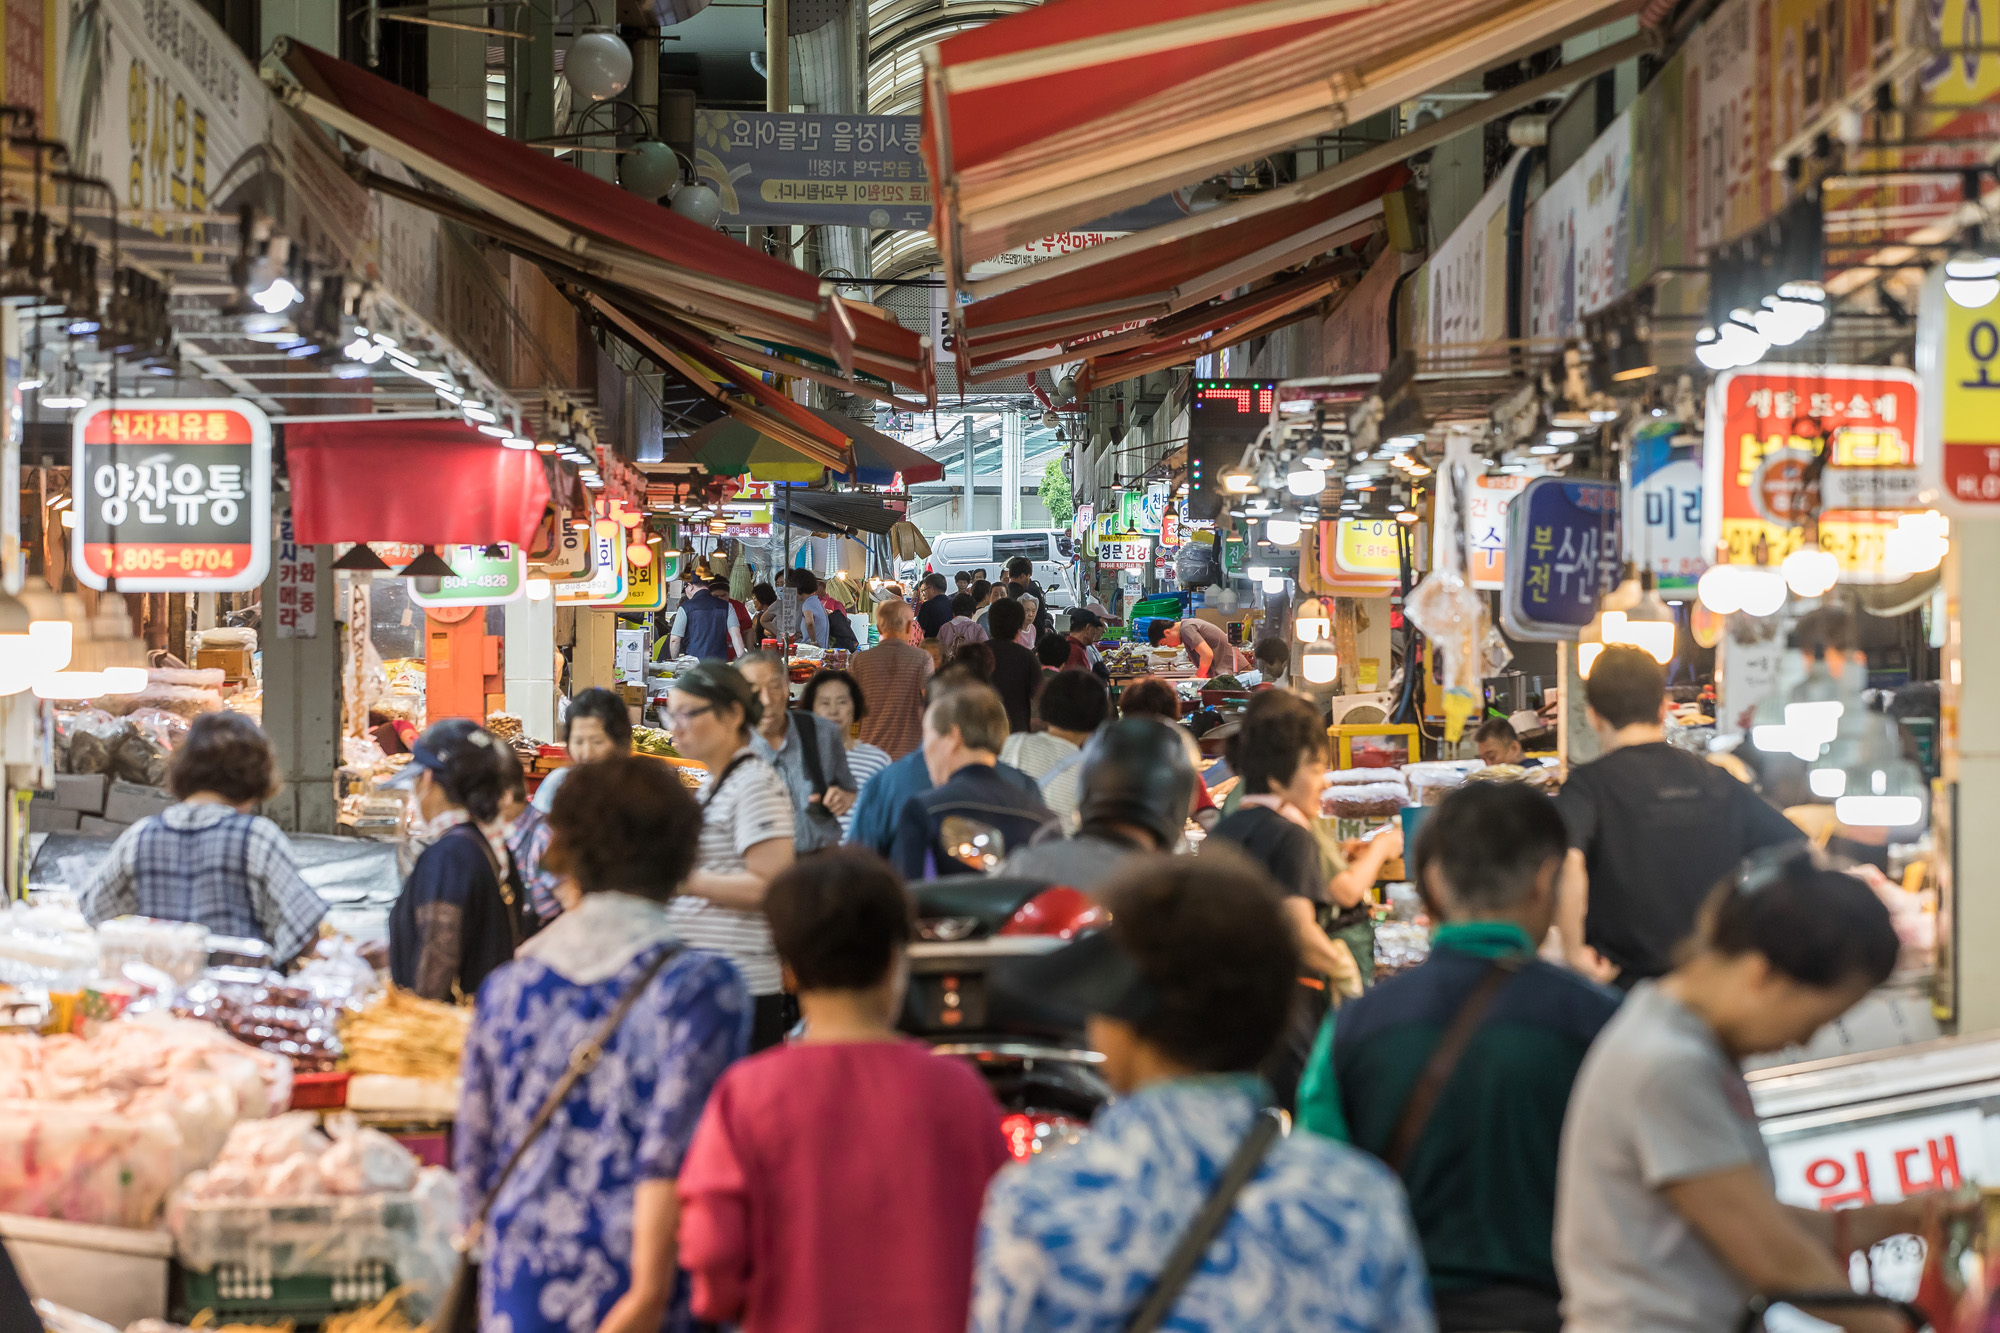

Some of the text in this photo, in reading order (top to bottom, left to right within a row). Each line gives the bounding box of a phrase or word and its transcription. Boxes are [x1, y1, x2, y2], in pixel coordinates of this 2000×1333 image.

[111, 412, 229, 441] 식자재유통
[94, 462, 245, 526] 양산유통
[101, 548, 234, 572] T.805-8704
[1101, 543, 1123, 560] 성문
[1527, 525, 1553, 603] 부전
[443, 575, 509, 589] 804-4828
